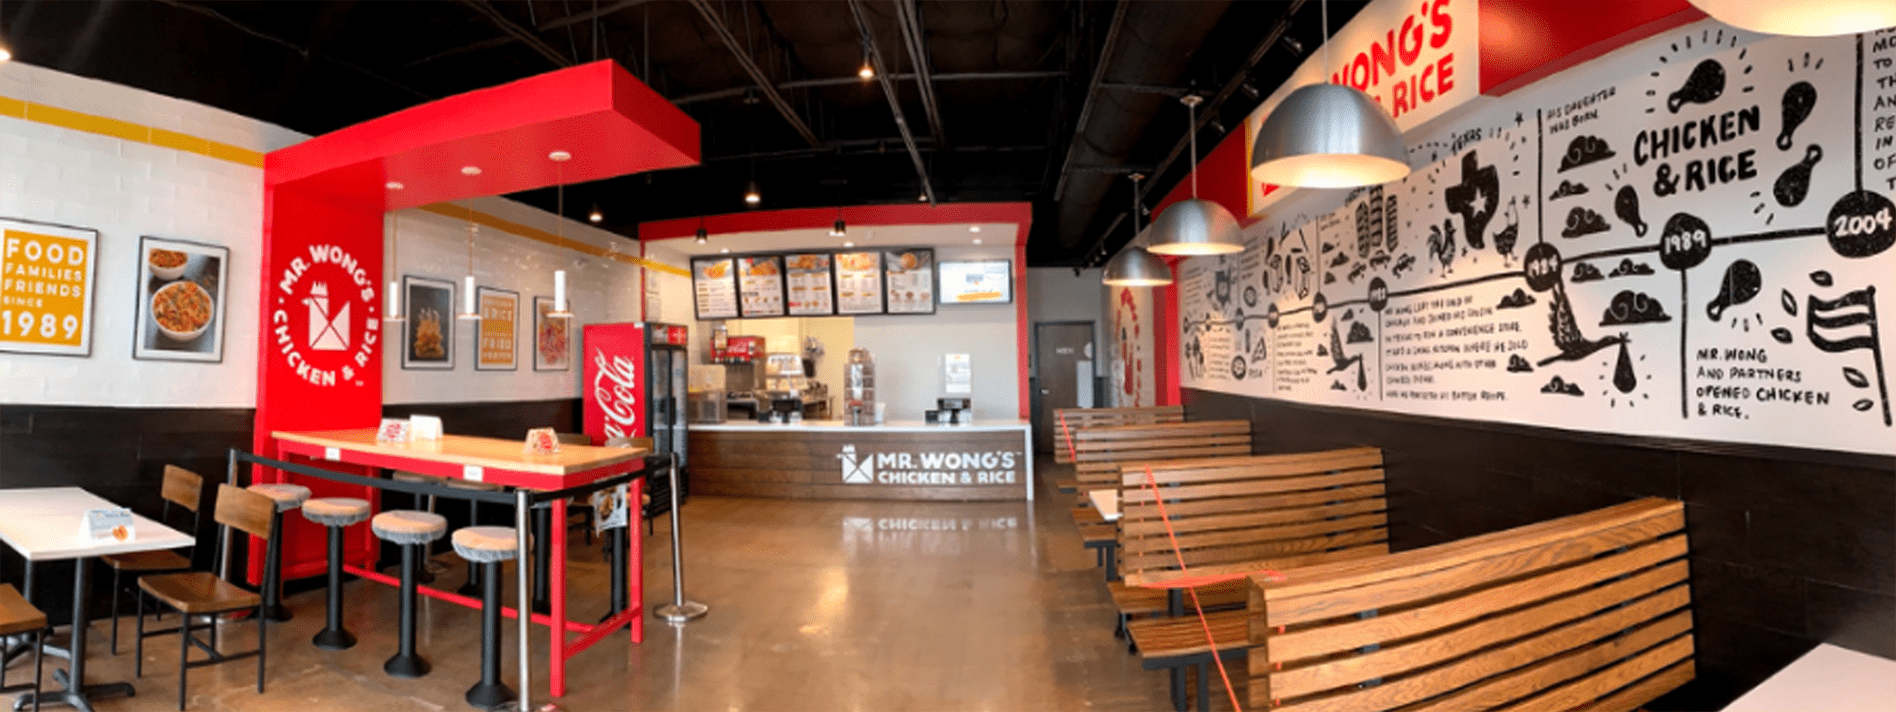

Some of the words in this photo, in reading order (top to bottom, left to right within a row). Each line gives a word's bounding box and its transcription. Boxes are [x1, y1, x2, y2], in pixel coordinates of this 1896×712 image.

[1873, 57, 1892, 70] TO
[1393, 52, 1454, 119] RICE
[1634, 104, 1760, 167] CHICKEN
[1653, 163, 1680, 197] &
[1685, 149, 1758, 192] RICE
[1834, 206, 1893, 238] 2004
[6, 237, 84, 266] FOOD
[1665, 230, 1707, 254] 1989
[5, 262, 82, 282] FAMILIES
[279, 256, 312, 295] MR.
[308, 244, 375, 302] WONG'S
[4, 278, 81, 298] FRIENDS
[2, 309, 78, 341] 1989
[274, 309, 337, 387] CHICKEN
[354, 317, 379, 368] RICE
[1724, 348, 1768, 364] WONG
[1697, 366, 1724, 380] AND
[1729, 367, 1802, 383] PARTNERS
[1696, 385, 1751, 399] OPENED
[1756, 387, 1831, 406] CHICKEN
[1712, 403, 1750, 420] RICE.
[877, 452, 918, 470] MR.
[920, 450, 1016, 470] WONG'S
[877, 470, 957, 485] CHICKEN
[977, 470, 1016, 485] RICE
